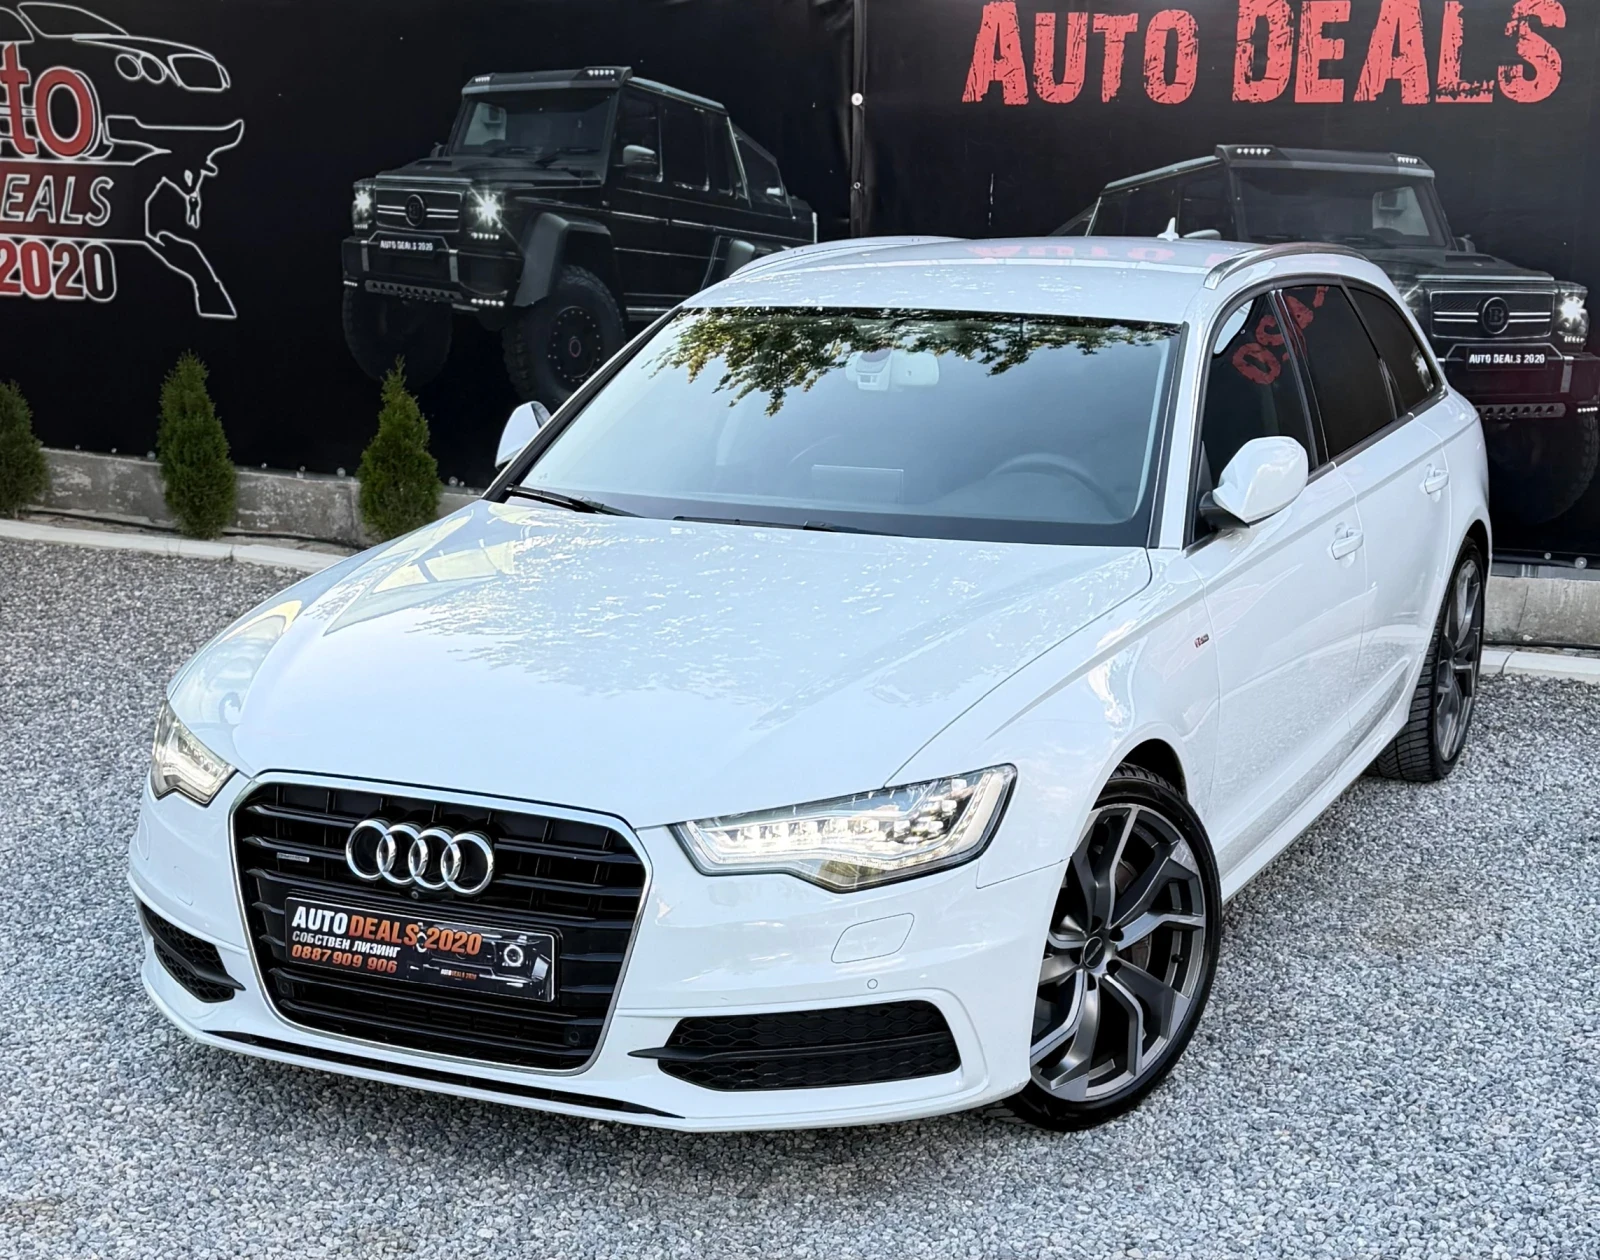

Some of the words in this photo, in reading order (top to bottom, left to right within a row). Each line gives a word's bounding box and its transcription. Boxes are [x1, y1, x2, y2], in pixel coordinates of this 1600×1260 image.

[1232, 0, 1567, 105] DEALS
[0, 238, 118, 302] 2020
[1468, 353, 1491, 364] AUTO
[1493, 353, 1522, 364] DEALS
[1523, 353, 1545, 364] 2020
[292, 930, 351, 951] СОБСТВЕН
[352, 941, 402, 958] ЛИЗИНГ
[424, 927, 483, 955] 2020
[291, 944, 332, 962] 0887
[332, 951, 363, 968] 909
[367, 957, 398, 974] 906
